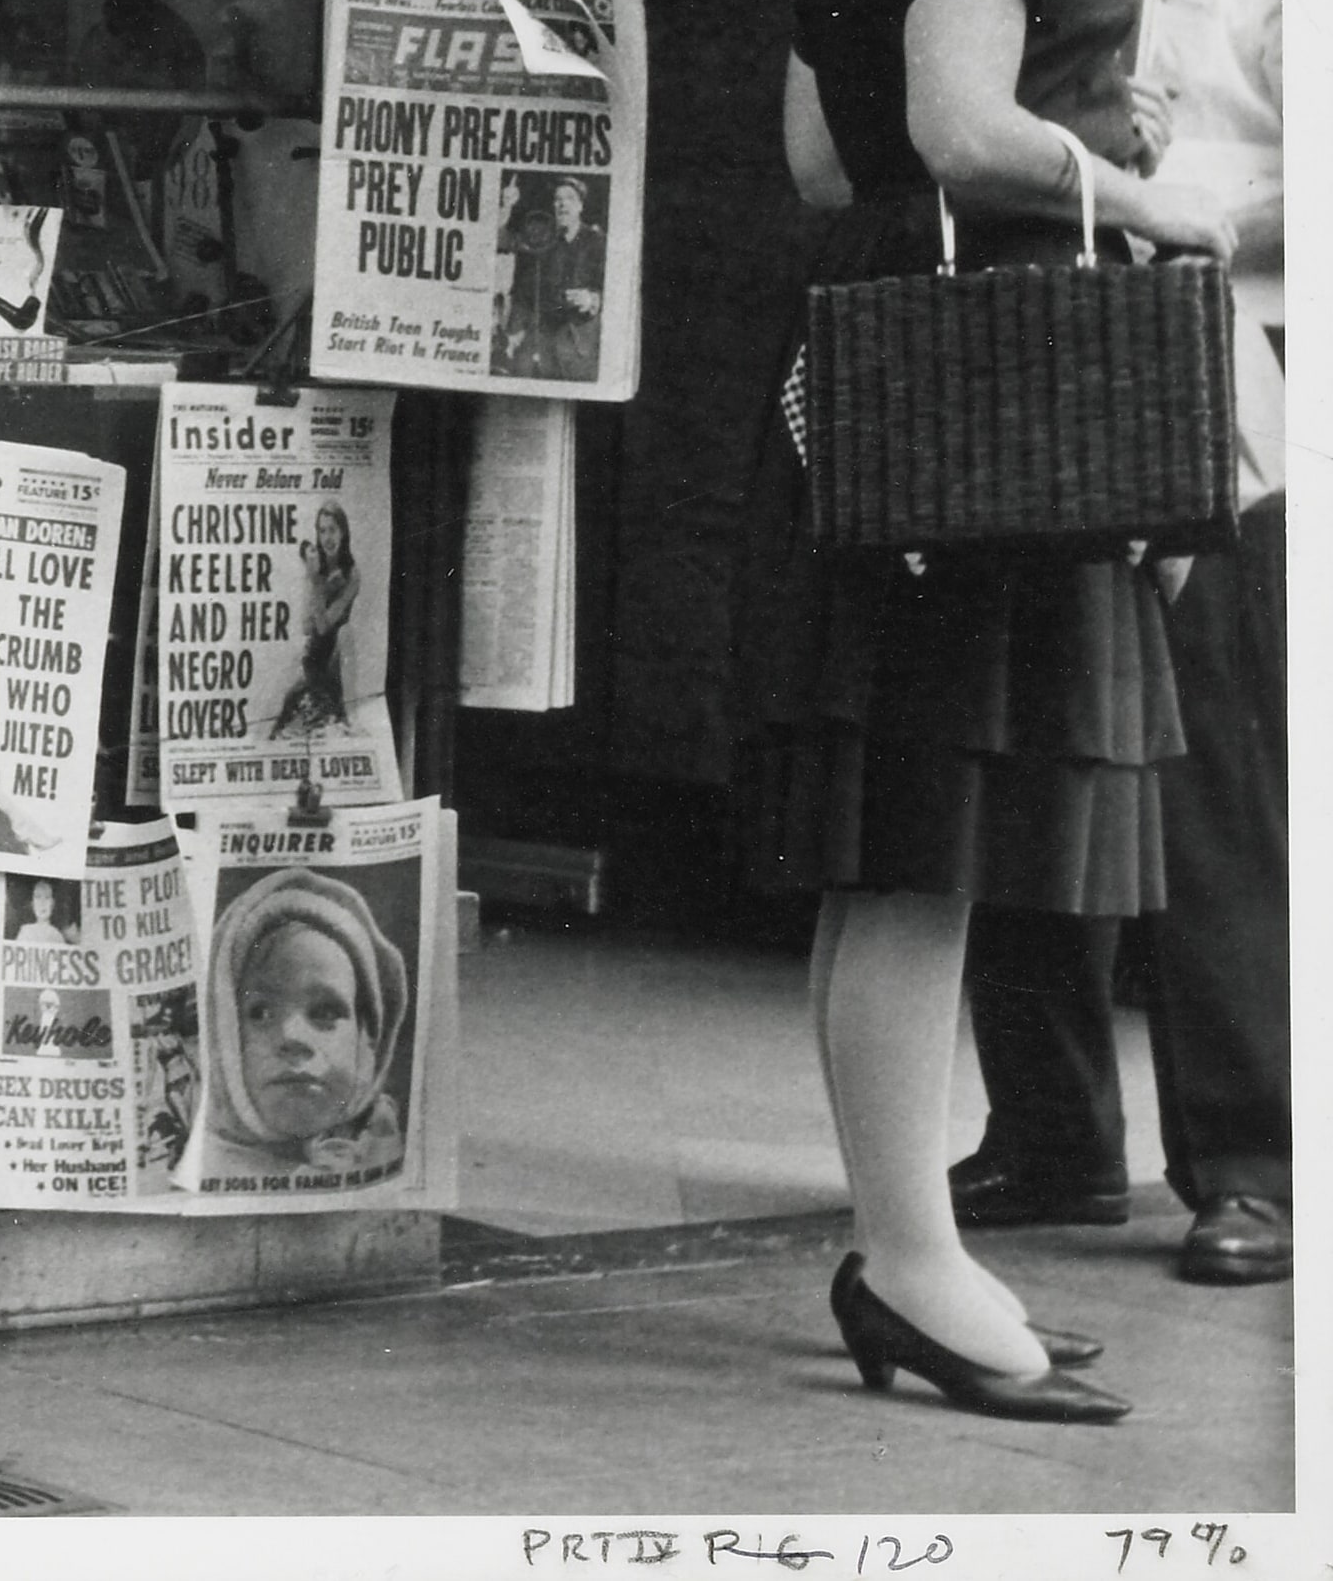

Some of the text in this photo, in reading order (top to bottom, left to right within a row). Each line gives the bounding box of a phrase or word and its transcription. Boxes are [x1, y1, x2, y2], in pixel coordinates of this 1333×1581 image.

[335, 96, 612, 167] PHONY PREACHERS
[346, 160, 483, 222] PREY ON
[358, 221, 464, 282] PUBLIC
[170, 417, 295, 452] Insider
[204, 467, 344, 491] Never Before Told
[171, 504, 298, 545] CHRISTINE
[28, 551, 95, 591] LOVE
[169, 553, 272, 594] KEELER
[19, 594, 67, 631] THE
[169, 601, 290, 643] AND HER
[168, 650, 253, 692] NEGRO
[7, 677, 71, 717] WHO
[0, 719, 74, 759] JILTED
[167, 697, 248, 741] LOVERS
[13, 764, 58, 800] ME!
[858, 1534, 955, 1575] 120
